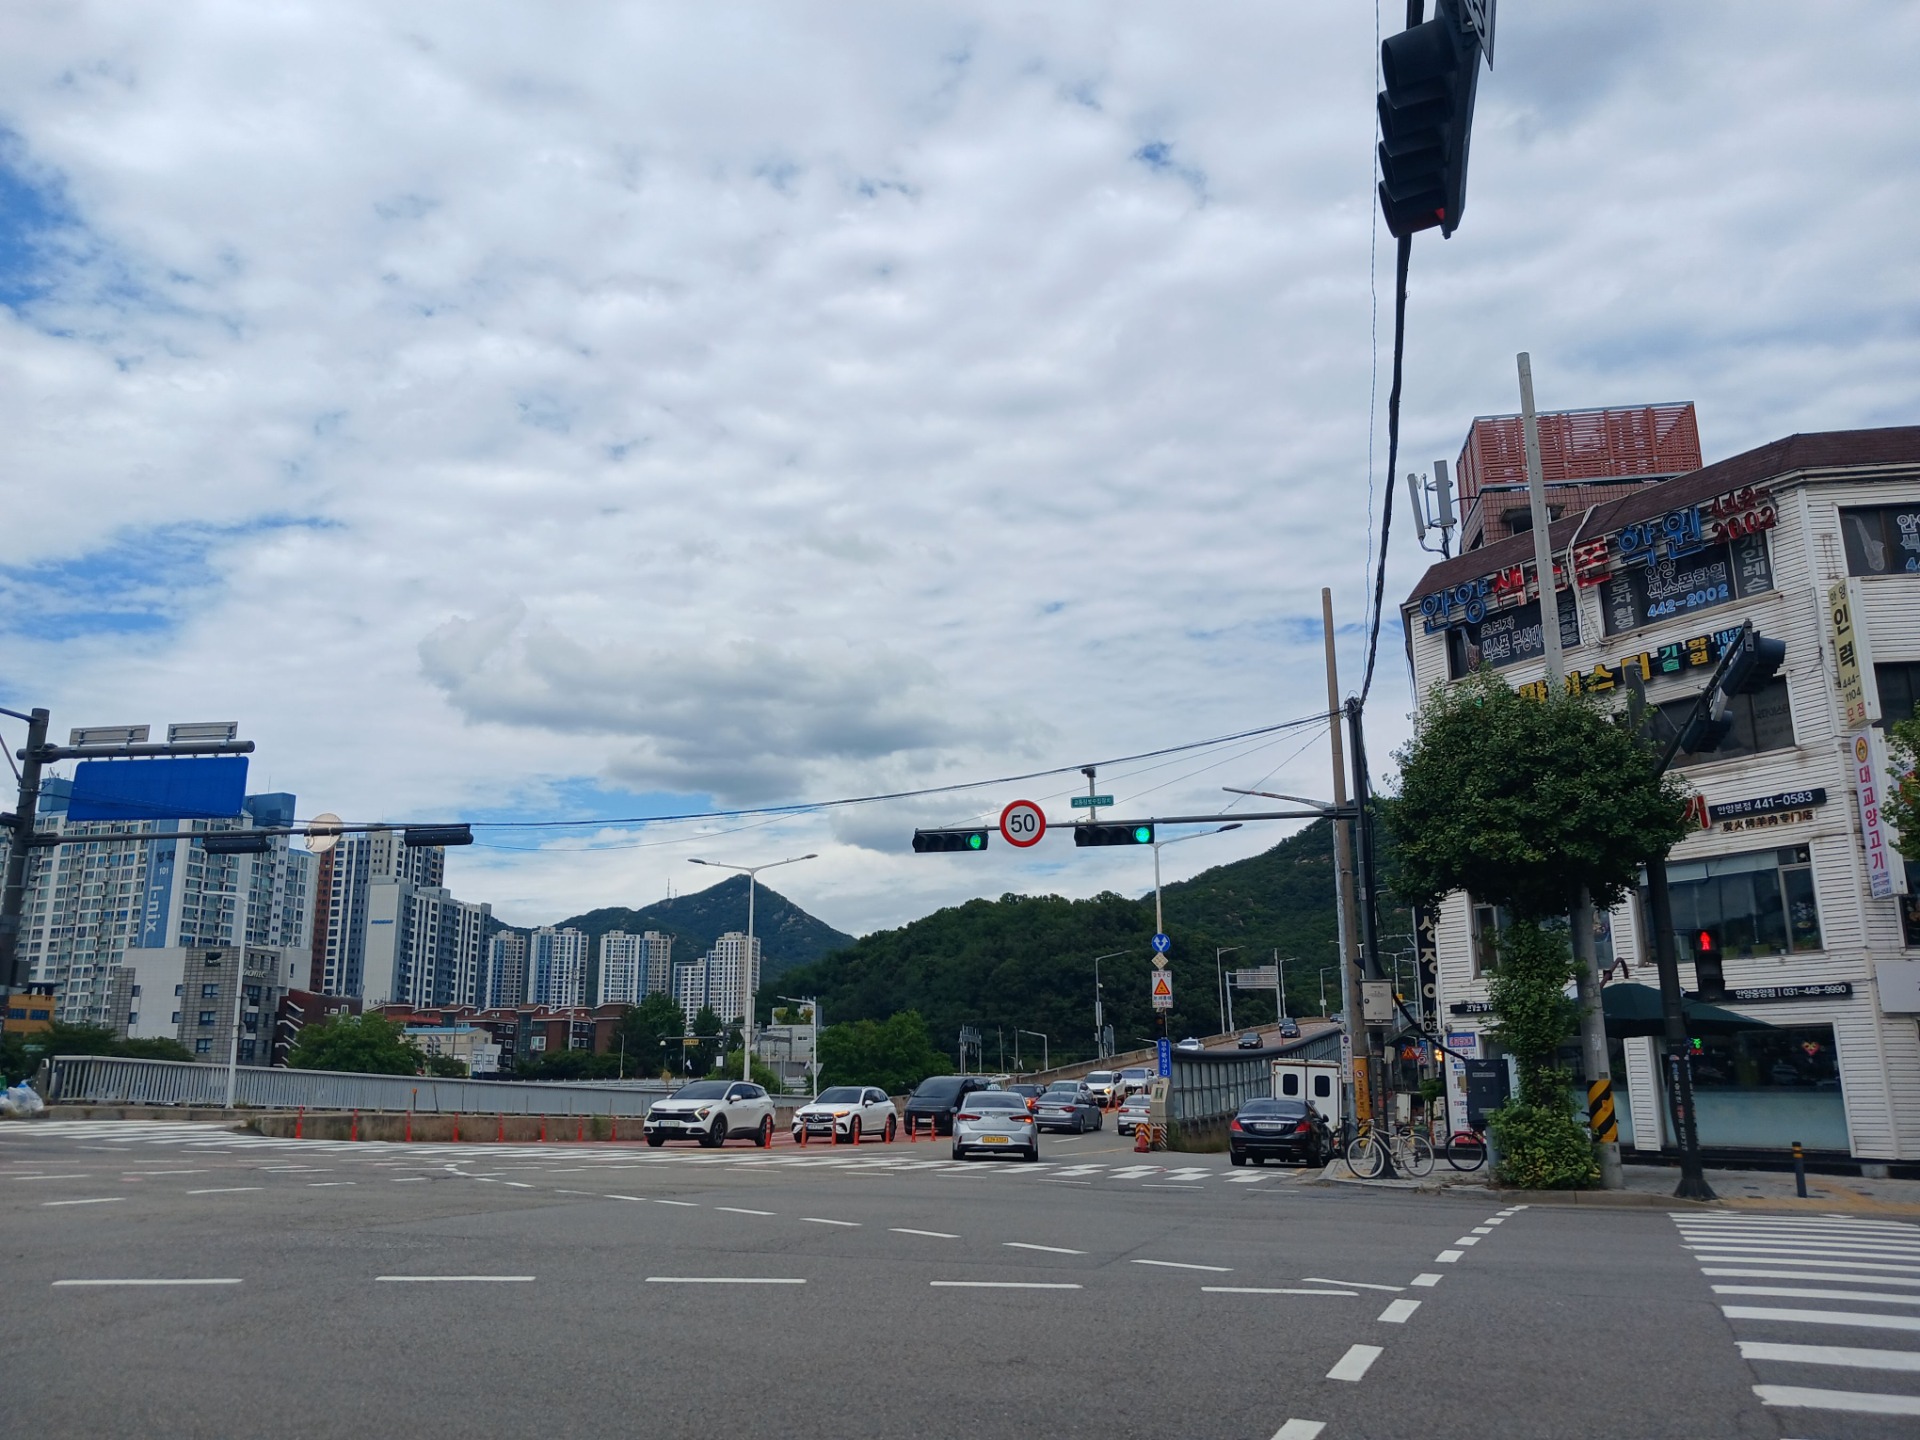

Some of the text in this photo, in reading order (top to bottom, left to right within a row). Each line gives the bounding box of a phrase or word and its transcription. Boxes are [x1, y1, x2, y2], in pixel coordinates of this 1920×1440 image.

[1712, 506, 1779, 544] 2002
[1896, 513, 1920, 534] 안
[1420, 578, 1488, 635] 안양
[1616, 504, 1706, 567] 학원
[1645, 559, 1676, 583] 안양
[1905, 556, 1920, 572] 4
[1646, 561, 1726, 600] 색소폰학원
[1647, 584, 1729, 618] 442-2002
[1481, 616, 1515, 638] 초보자
[1833, 604, 1856, 668] 인력
[1482, 634, 1511, 662] 색소폰
[1660, 644, 1680, 673] 기술
[1687, 637, 1709, 666] 학원
[1717, 791, 1813, 815] 안양본점 441-0583
[1011, 813, 1035, 833] 50
[1858, 764, 1885, 870] 대교양고기
[160, 867, 169, 875] 101
[1735, 984, 1847, 999] 안양중앙점 031-449-9990
